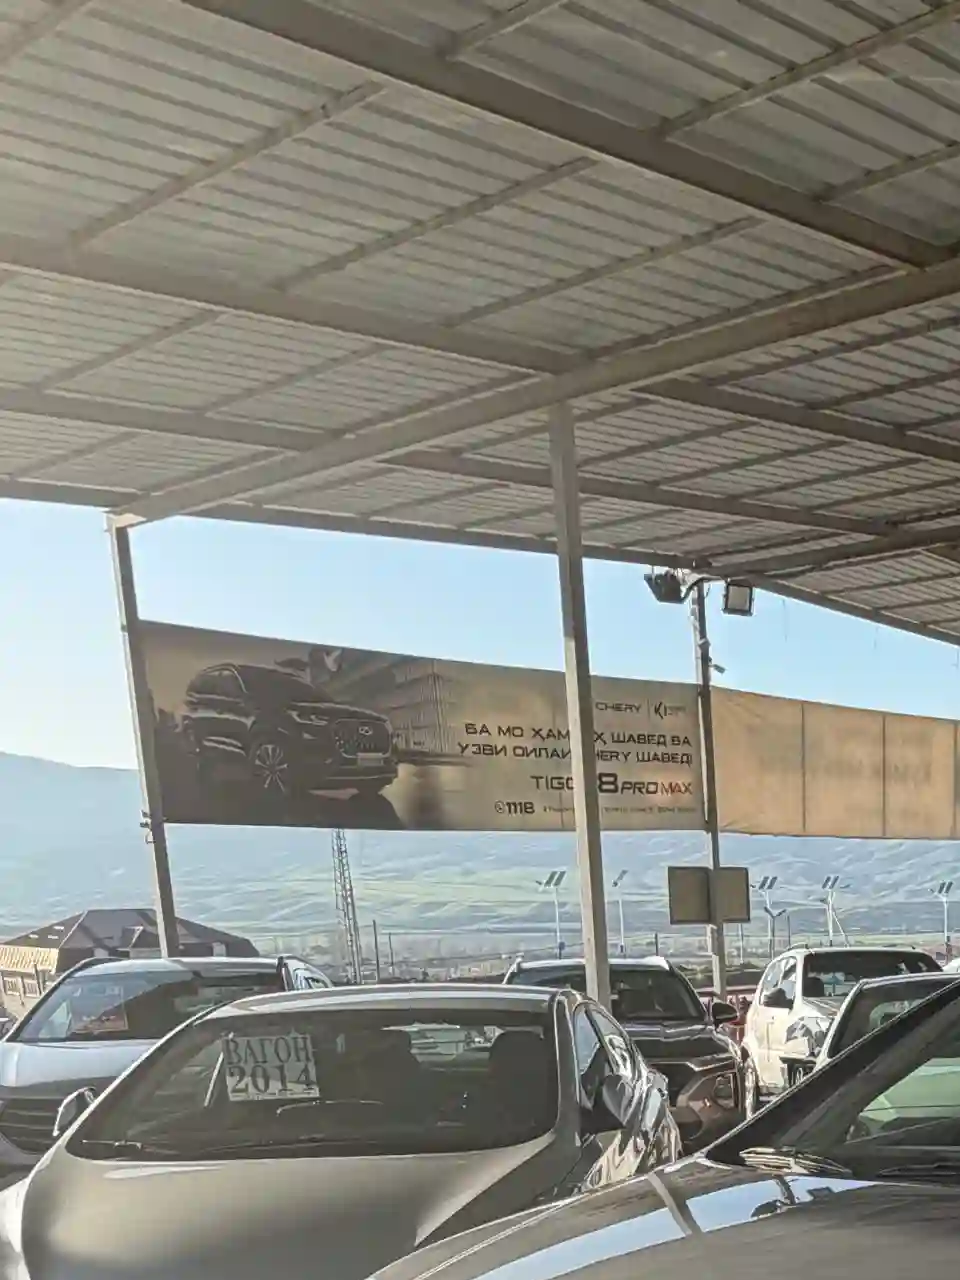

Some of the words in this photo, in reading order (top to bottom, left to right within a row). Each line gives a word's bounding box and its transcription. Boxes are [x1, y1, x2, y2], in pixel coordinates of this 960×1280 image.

[595, 701, 642, 713] CHERY
[497, 725, 524, 738] МО
[611, 731, 668, 748] ШАВЕД
[671, 735, 692, 747] ВА
[596, 749, 632, 763] ERY
[530, 775, 575, 791] TIG
[660, 781, 693, 796] MAX
